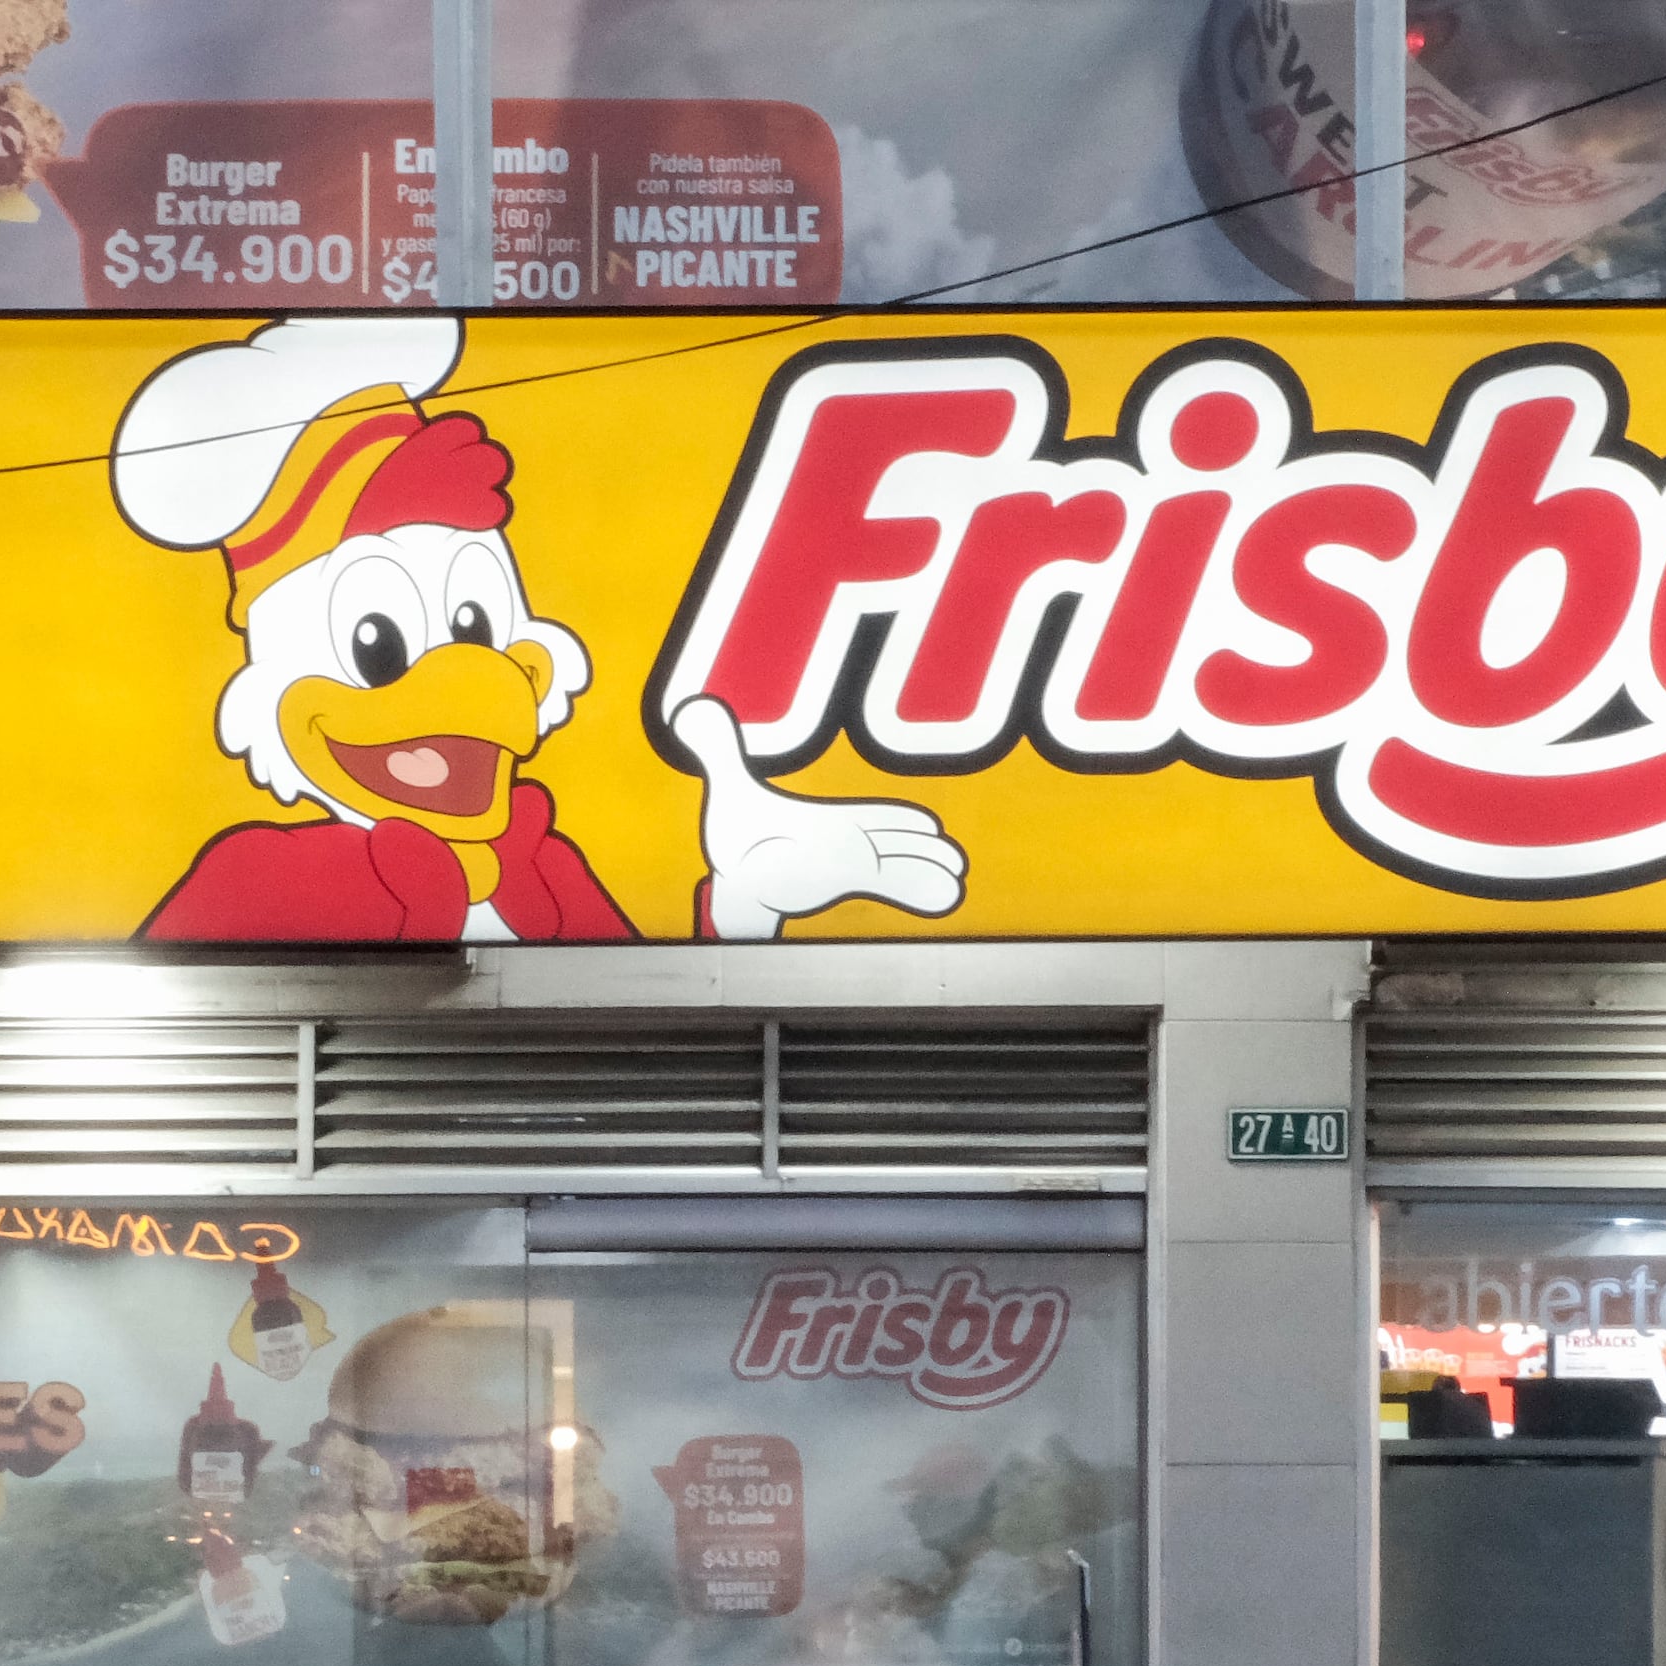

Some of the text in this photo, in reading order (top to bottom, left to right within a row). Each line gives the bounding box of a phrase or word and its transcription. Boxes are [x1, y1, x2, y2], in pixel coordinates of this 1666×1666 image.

[166, 153, 282, 195] Burger
[395, 137, 569, 174] En mbo
[708, 153, 781, 174] también
[637, 176, 795, 195] con nuestra salsa
[156, 191, 301, 225] Extrema
[614, 205, 820, 243] NASHVILLE
[103, 228, 353, 289] $34.900
[382, 238, 392, 257] y
[382, 256, 580, 304] $4500
[636, 250, 797, 288] PICANTE
[1238, 1115, 1273, 1153] 27
[1304, 1114, 1337, 1153] 40
[735, 1270, 1066, 1407] Frisby
